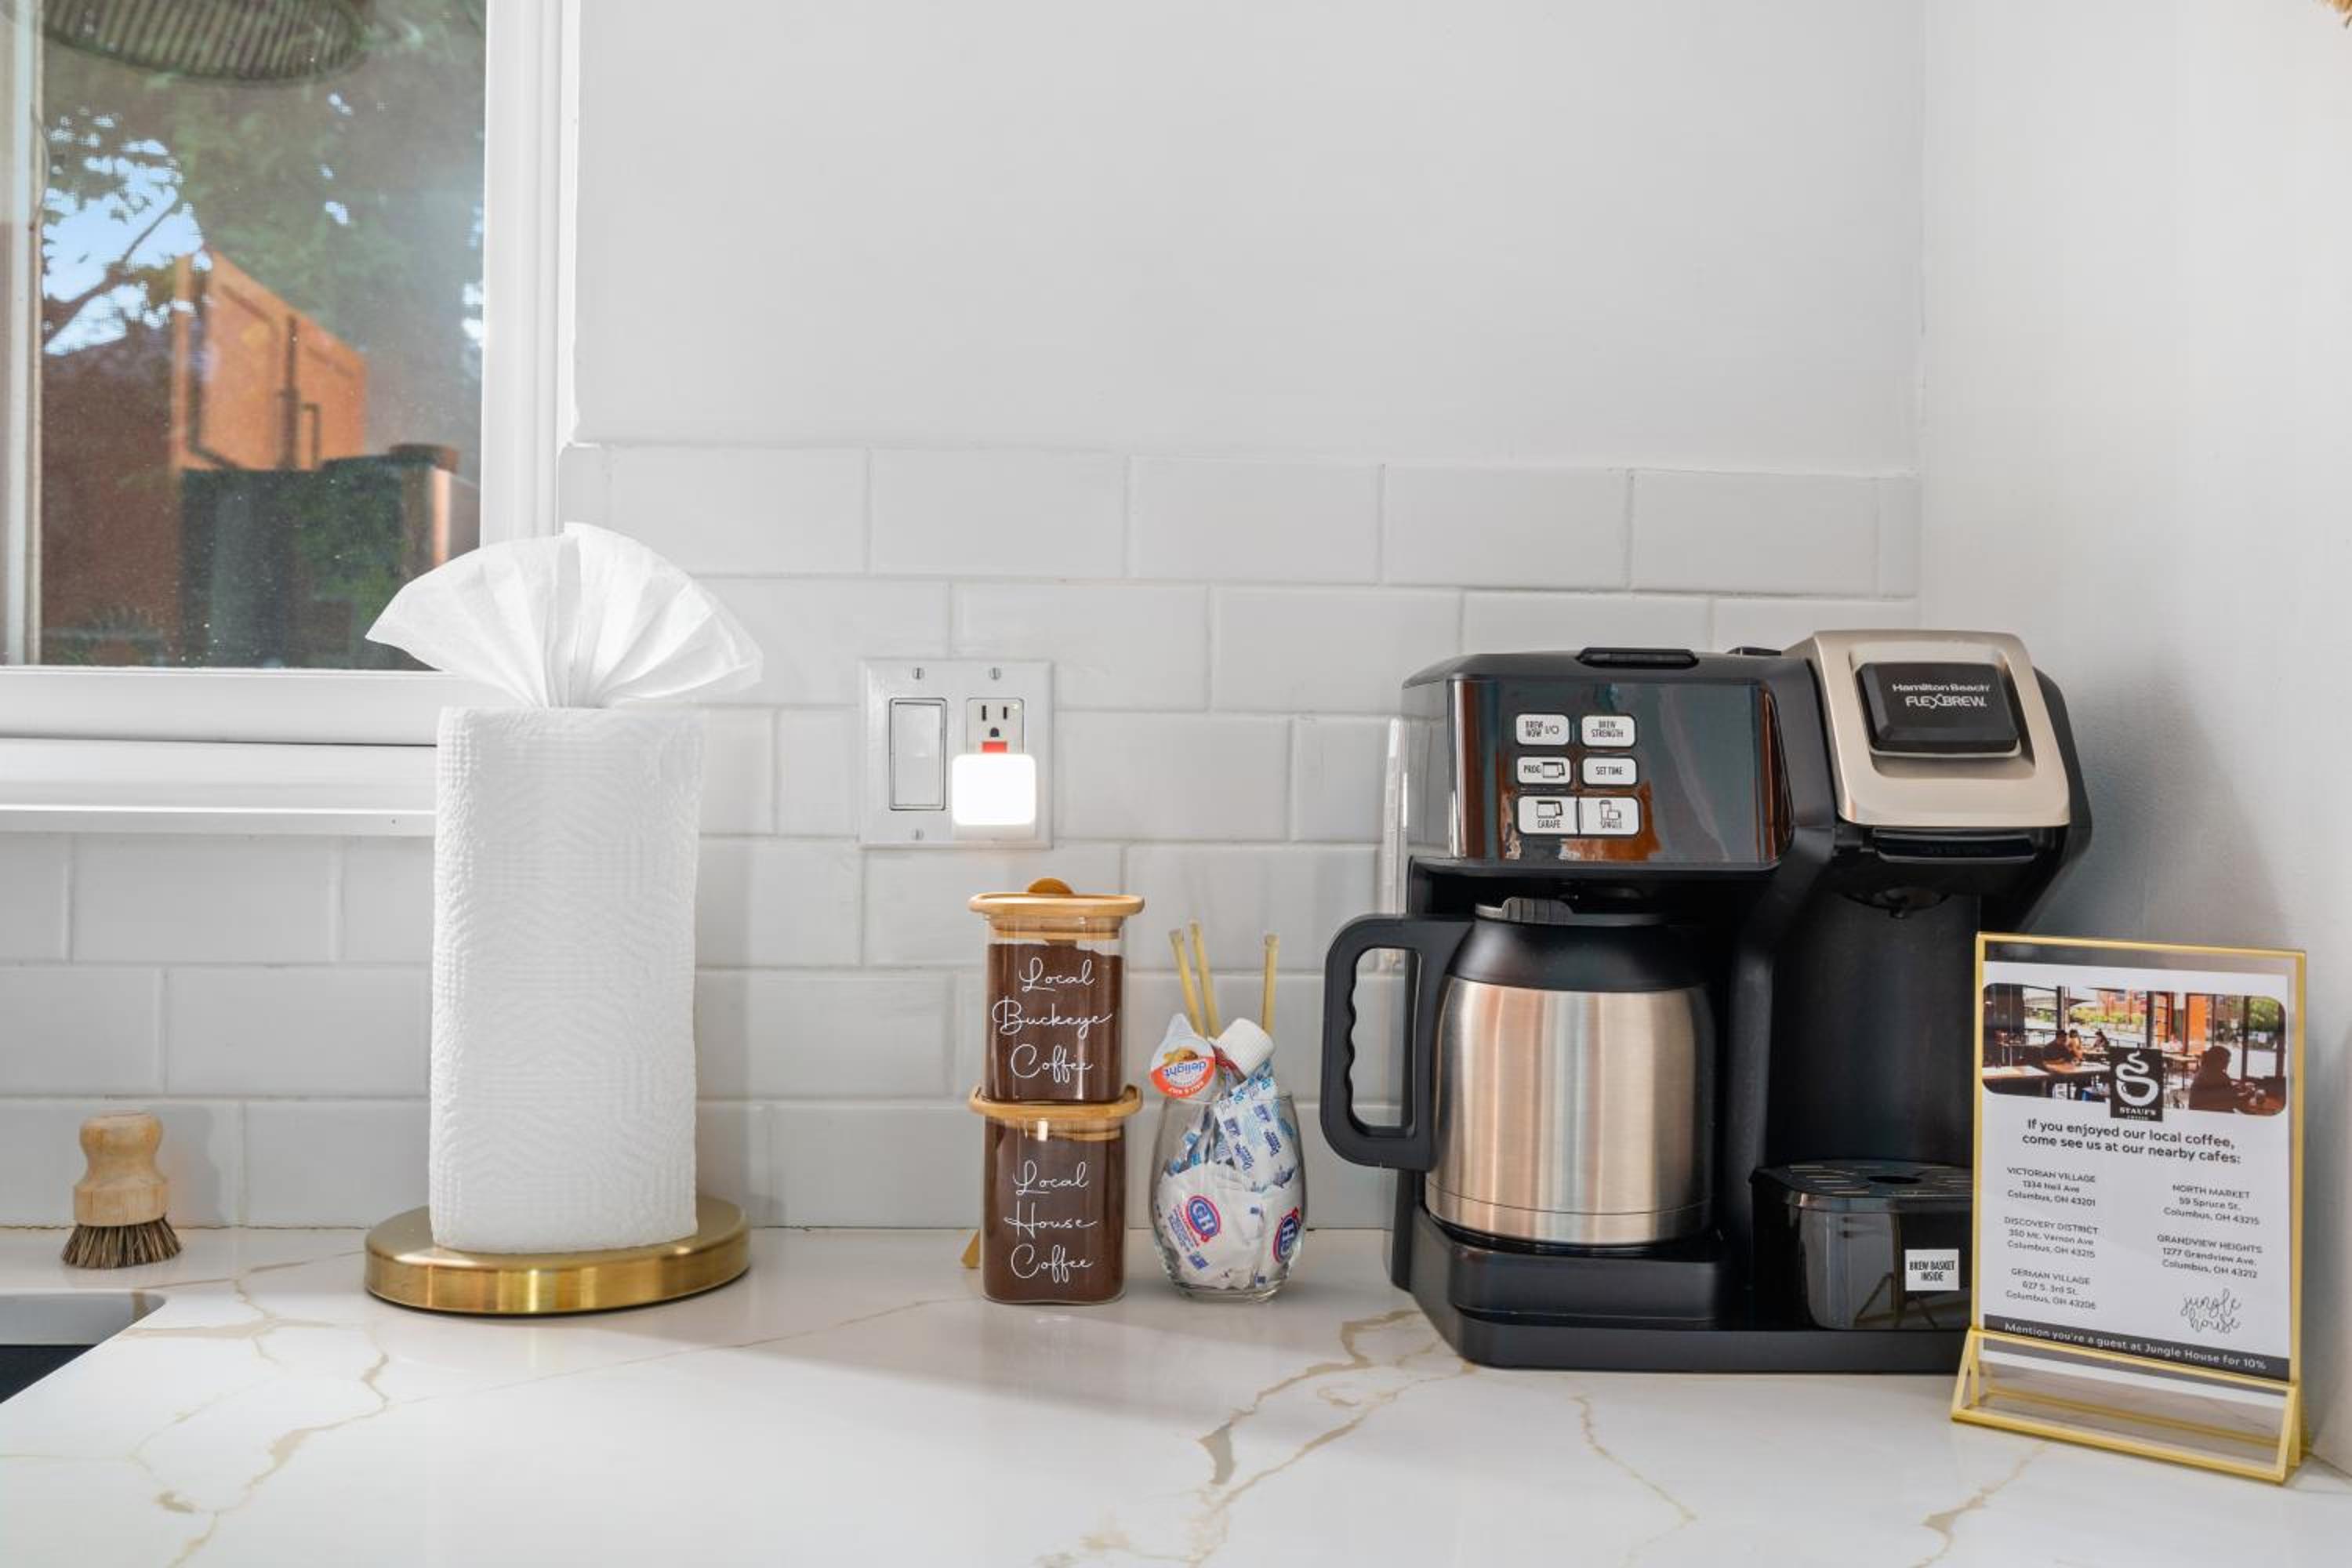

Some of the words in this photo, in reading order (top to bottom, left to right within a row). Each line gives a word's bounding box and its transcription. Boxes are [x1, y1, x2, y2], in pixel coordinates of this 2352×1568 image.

[1892, 683, 1949, 692] Hamilton
[1950, 683, 1990, 692] Beach
[1591, 729, 1624, 738] STRENGTH
[1595, 766, 1606, 775] SET
[1537, 819, 1561, 829] CARAFE
[1019, 956, 1095, 992] Local
[992, 996, 1112, 1040] Buckeye
[1011, 1044, 1094, 1083] Coffee
[1164, 1061, 1207, 1078] delight
[2027, 1118, 2037, 1129] If
[2040, 1121, 2063, 1132] you
[2067, 1123, 2119, 1137] enjoyed
[2123, 1130, 2145, 1139] our
[2150, 1129, 2181, 1142] local
[2186, 1134, 2235, 1149] coffee,
[2022, 1135, 2057, 1146] come
[2060, 1138, 2083, 1149] see
[2105, 1142, 2118, 1152] at
[2122, 1144, 2144, 1154] our
[2148, 1145, 2195, 1161] nearby
[2199, 1151, 2241, 1164] cafes:
[1013, 1160, 1091, 1196] Local
[2007, 1167, 2056, 1178] VICTORIAN
[2058, 1172, 2095, 1182] VILLAGE
[2008, 1190, 2053, 1203] Columbus,
[2054, 1195, 2068, 1203] OH
[2071, 1198, 2096, 1207] 43201
[2172, 1185, 2207, 1195] NORTH
[2209, 1188, 2250, 1199] MARKET
[2193, 1198, 2226, 1209] Spruce
[1004, 1200, 1098, 1239] House
[2163, 1207, 2212, 1221] Columbus,
[2215, 1214, 2230, 1222] OH
[2232, 1215, 2259, 1225] 43215
[2004, 1217, 2055, 1229] DISCOVERY
[2057, 1222, 2098, 1234] DISTRICT
[2007, 1240, 2053, 1254] Columbus,
[2054, 1246, 2068, 1254] OH
[2044, 1234, 2074, 1243] Vernon
[2077, 1237, 2094, 1246] Ave
[2157, 1234, 2217, 1248] GRANDVIEW
[2220, 1240, 2263, 1254] HEIGHTS
[1011, 1243, 1094, 1283] Coffee
[2163, 1247, 2181, 1257] 1277
[2183, 1249, 2234, 1262] Grandview
[1909, 1261, 1929, 1270] BREW
[1930, 1261, 1955, 1270] BASKET
[2162, 1259, 2211, 1273] Columbus,
[2213, 1265, 2229, 1274] OH
[2231, 1268, 2257, 1279] 43212
[2011, 1268, 2050, 1279] GERMAN
[2052, 1274, 2091, 1285] VILLAGE
[2005, 1290, 2051, 1305] Columbus,
[2053, 1297, 2067, 1305] OH
[2050, 1285, 2064, 1294] 3rd
[2180, 1288, 2241, 1318] jungle
[2188, 1307, 2241, 1334] house
[2005, 1322, 2050, 1338] Mention
[2052, 1329, 2084, 1342] you're
[2096, 1338, 2127, 1351] guest
[2130, 1343, 2141, 1352] at
[2145, 1343, 2181, 1358] Jungle
[2184, 1349, 2220, 1363] House
[2223, 1355, 2241, 1366] for
